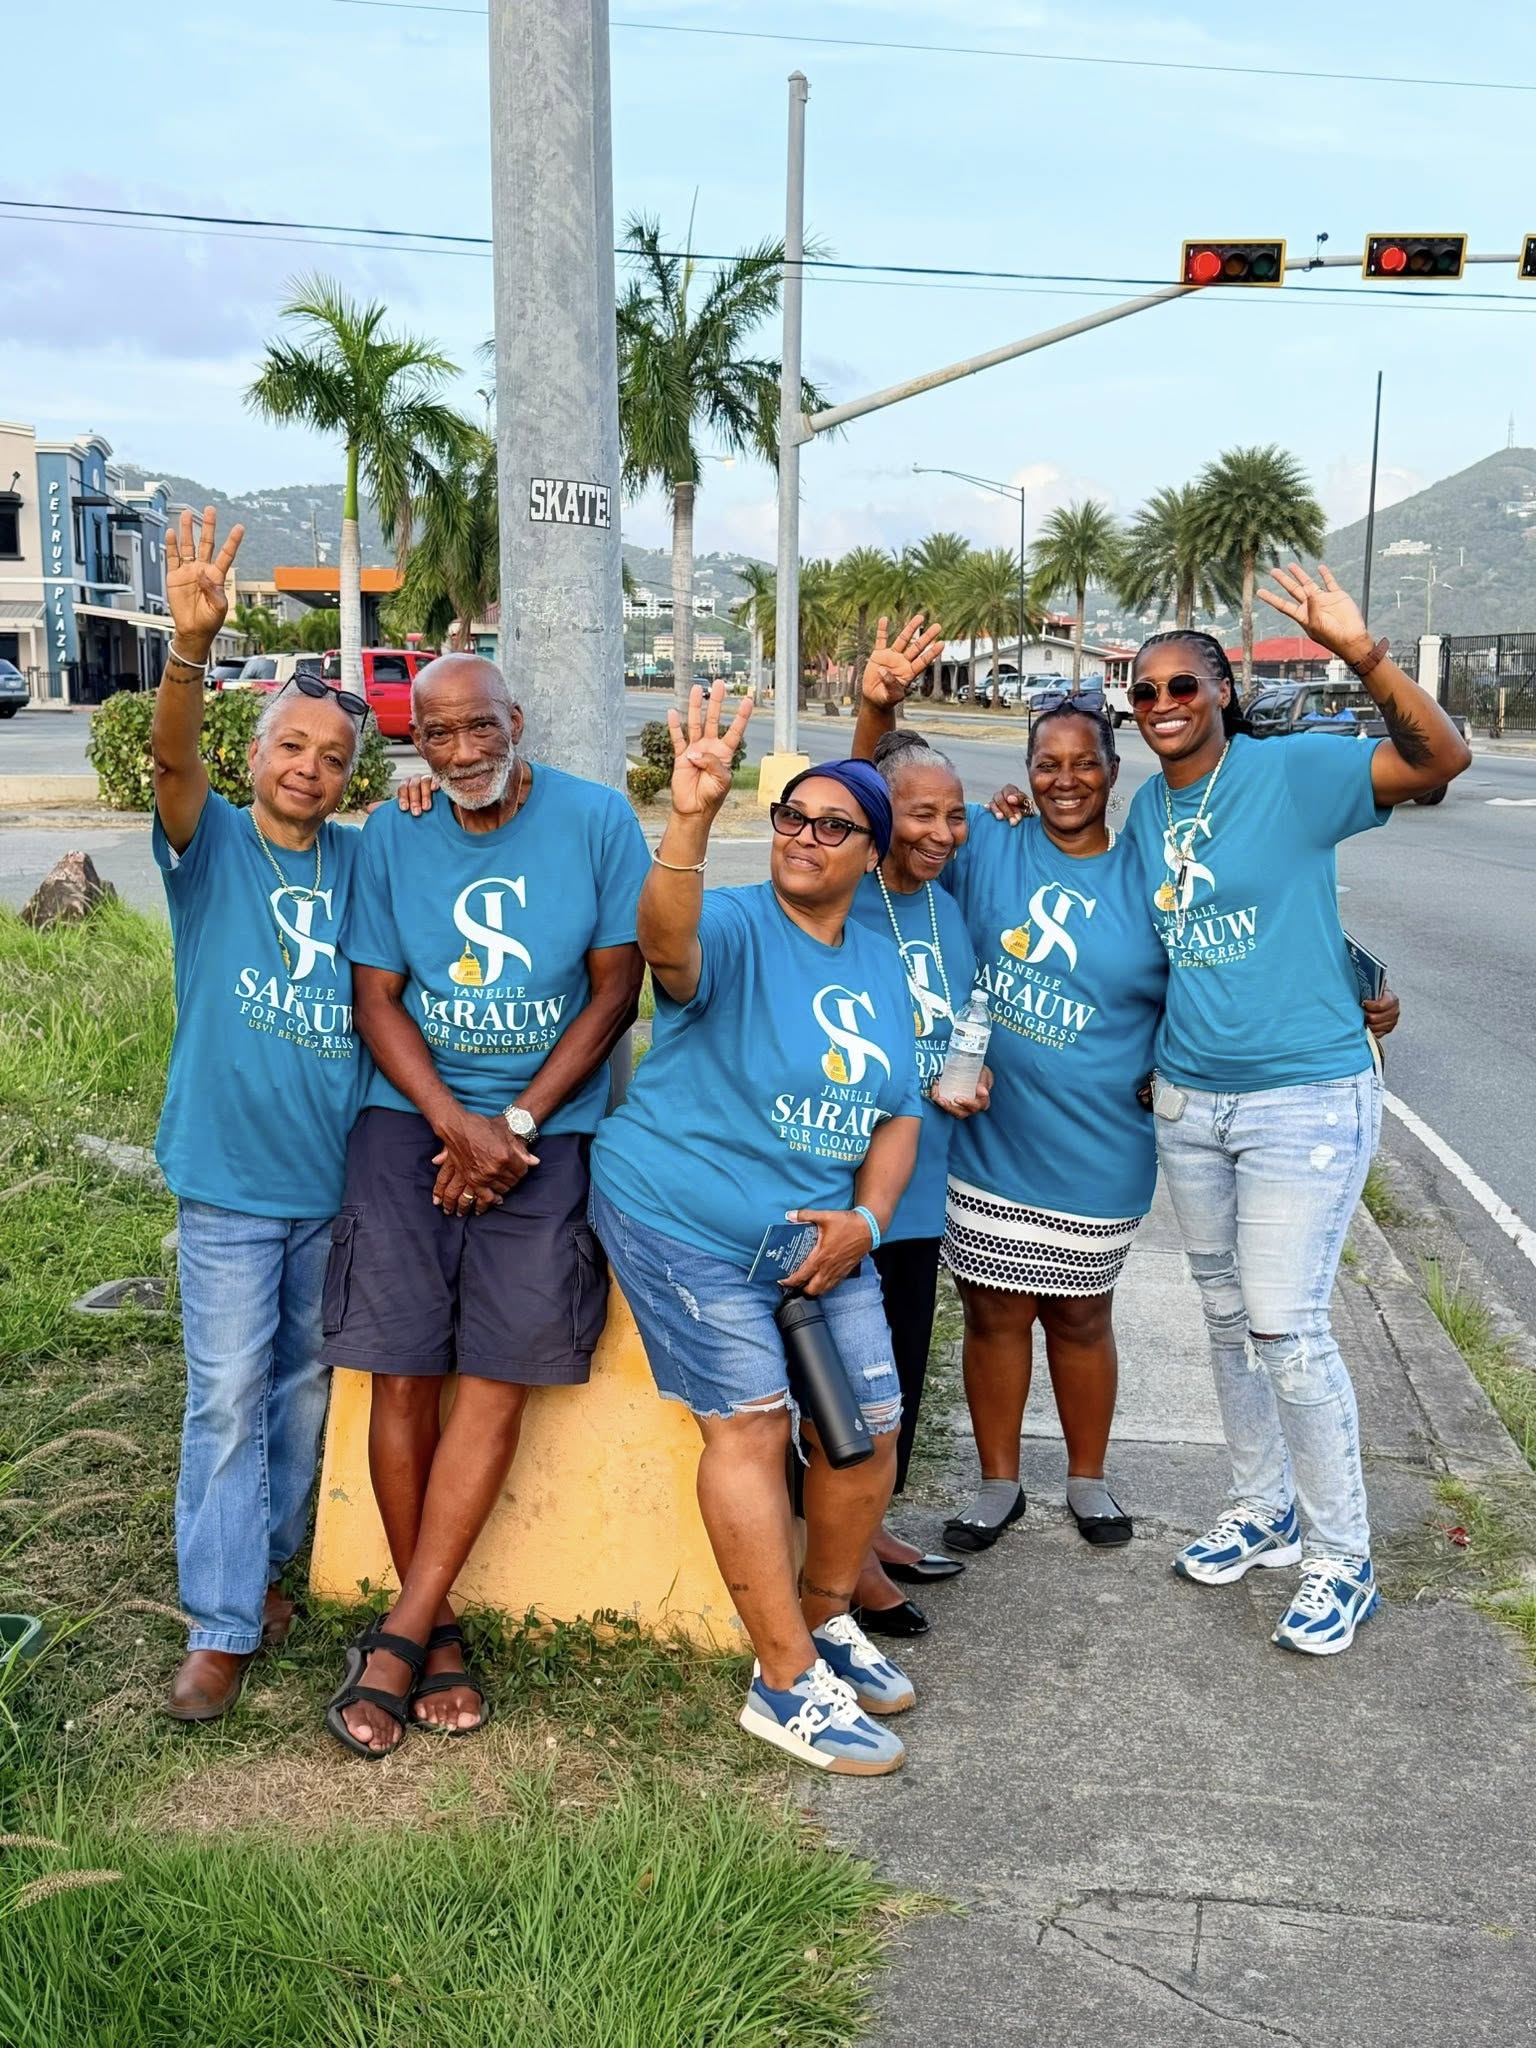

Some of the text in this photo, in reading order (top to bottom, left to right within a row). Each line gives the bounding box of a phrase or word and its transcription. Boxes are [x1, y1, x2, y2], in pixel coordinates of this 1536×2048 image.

[49, 481, 67, 663] PETRUS PLAZA
[996, 956, 1062, 991] JANELLE
[453, 987, 526, 999] JANELLE
[974, 957, 1096, 1031] ARAUW
[240, 1001, 276, 1024] FOR
[994, 1001, 1077, 1043] CONGRESS
[460, 1026, 557, 1046] CONGRESS
[990, 1012, 1064, 1050] EPRESENTATIVE
[453, 1042, 551, 1054] REPRESENTATIVE
[779, 1126, 811, 1143] FOR
